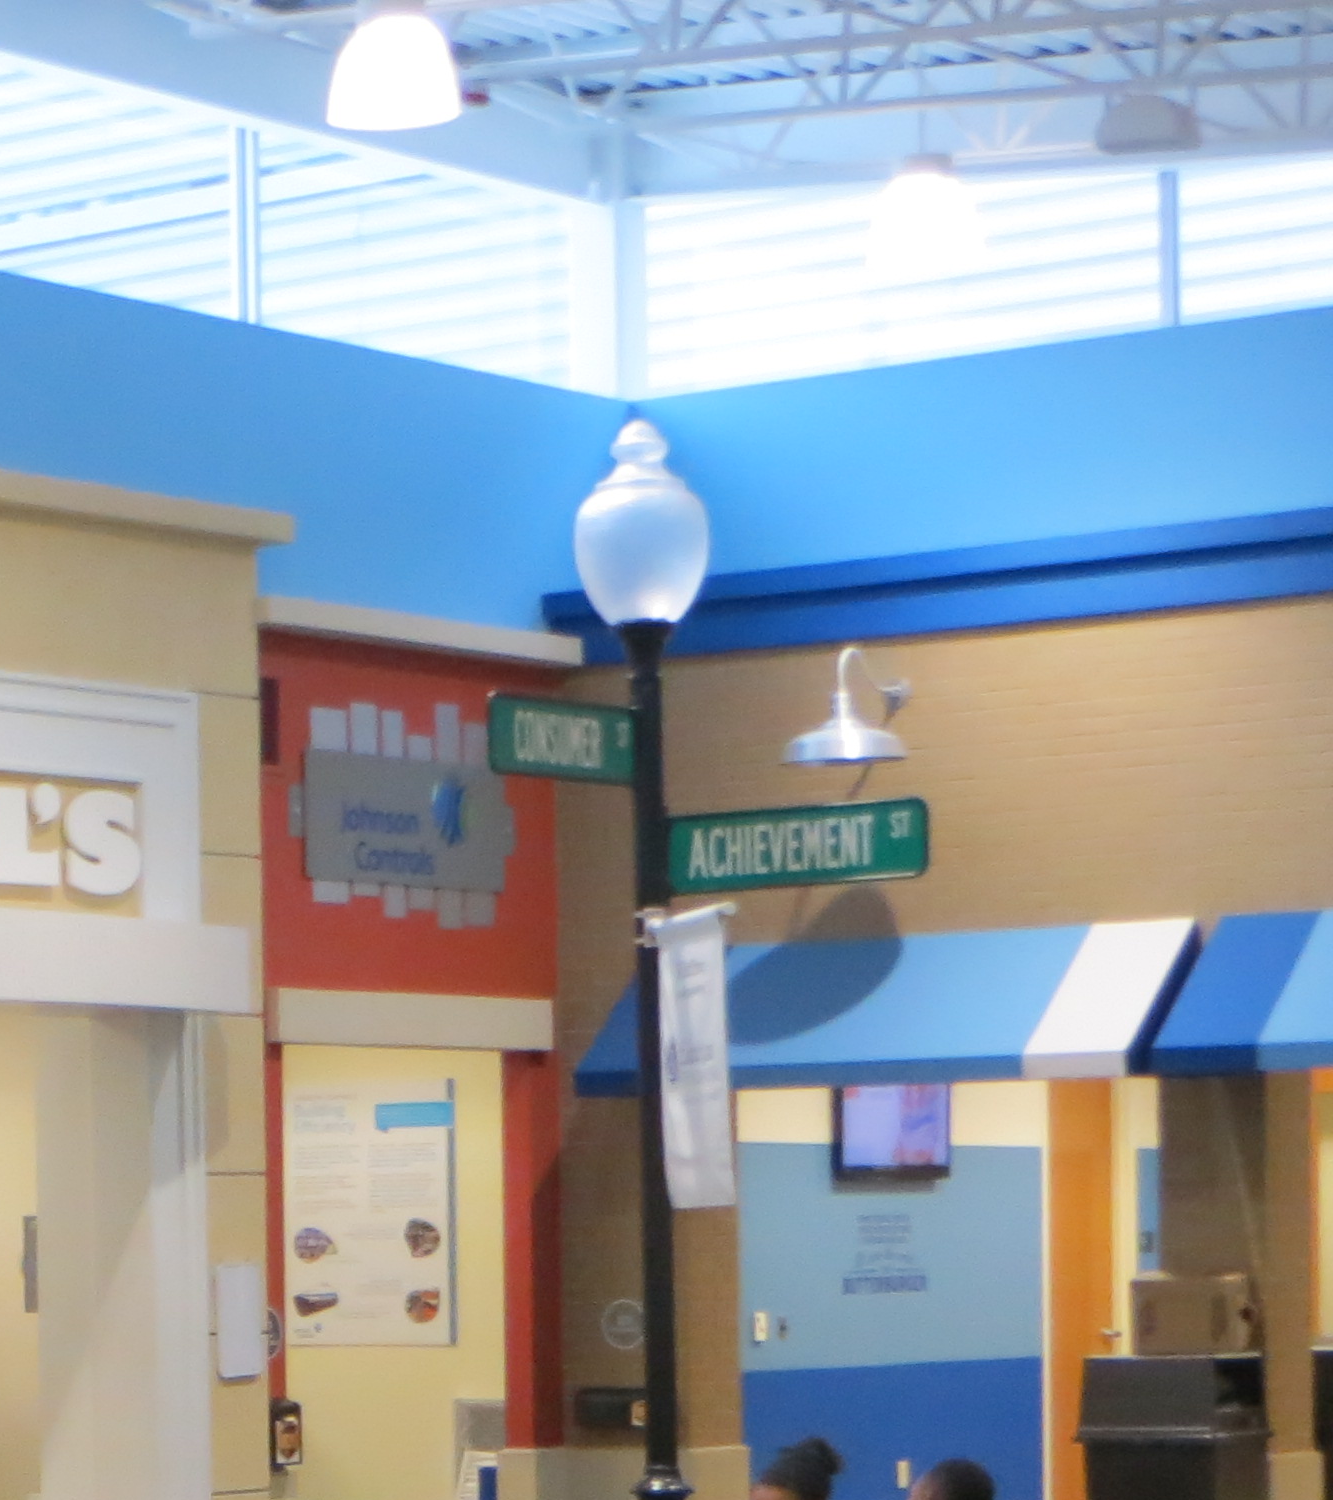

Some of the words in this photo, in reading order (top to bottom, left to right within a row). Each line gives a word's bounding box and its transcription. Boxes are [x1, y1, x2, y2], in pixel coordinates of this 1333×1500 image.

[340, 799, 421, 836] Johnson
[353, 841, 436, 877] Controls
[687, 813, 876, 881] ACHIEVEMENT
